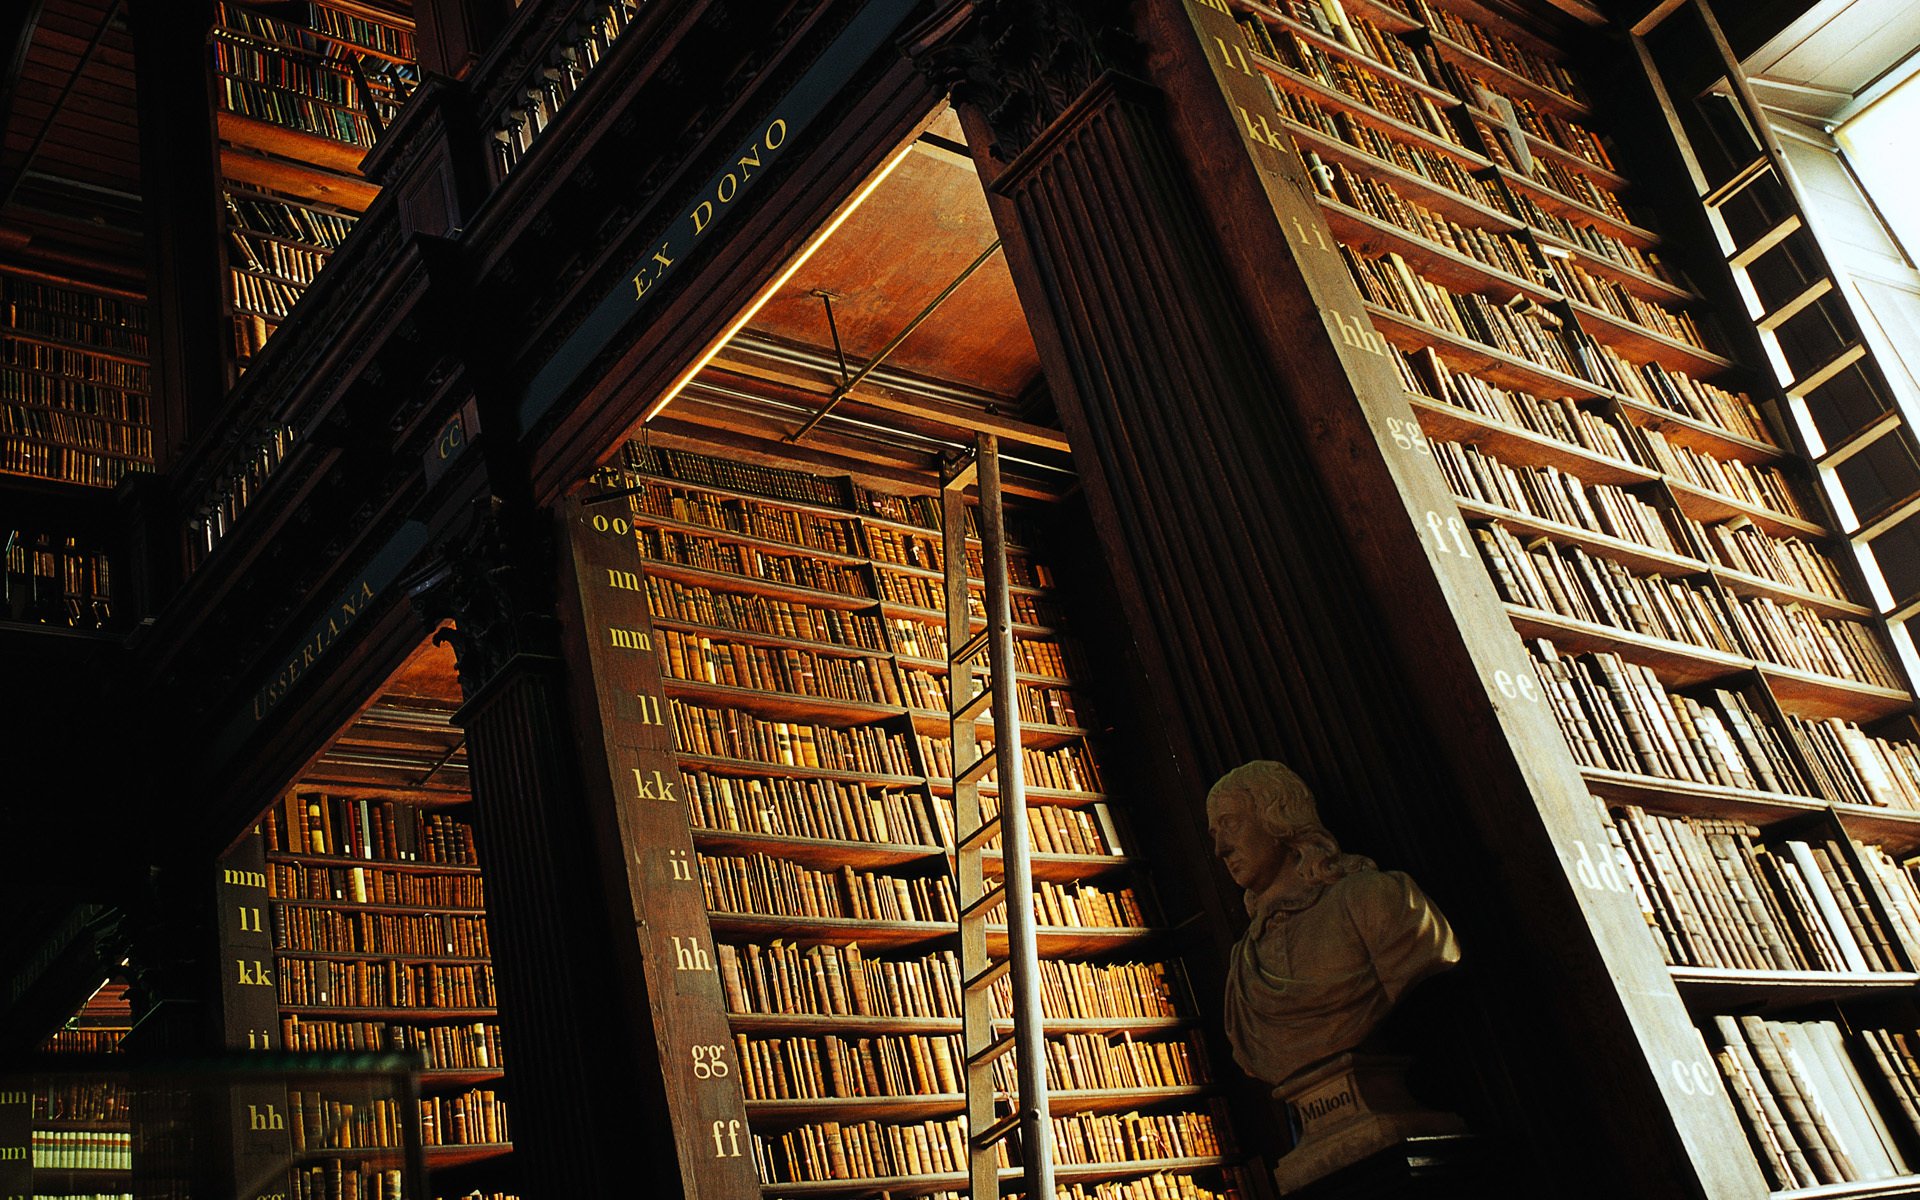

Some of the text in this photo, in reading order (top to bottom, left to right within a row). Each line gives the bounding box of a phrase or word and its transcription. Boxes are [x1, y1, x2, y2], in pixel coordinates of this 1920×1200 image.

[1215, 36, 1254, 77] ll
[1240, 106, 1288, 153] kk
[632, 117, 787, 301] EX DONO
[1293, 217, 1330, 252] ii
[1330, 310, 1384, 357] hh
[1387, 418, 1431, 455] gg
[1427, 511, 1471, 557] ff
[608, 569, 641, 592] nn
[253, 580, 374, 720] USSERIANA
[609, 628, 652, 651] mm
[1494, 670, 1537, 702] ee
[638, 695, 664, 726] ll
[632, 768, 678, 802] kk
[224, 869, 266, 888] mm
[669, 850, 692, 881] ii
[1573, 840, 1625, 893] dd
[240, 906, 262, 933] ll
[672, 937, 713, 971] hh
[236, 959, 273, 986] kk
[248, 1029, 270, 1050] ii
[692, 1044, 729, 1079] gg
[1673, 1059, 1715, 1095] cc
[248, 1104, 284, 1130] hh
[1302, 1091, 1350, 1124] Milton
[713, 1119, 742, 1158] ff
